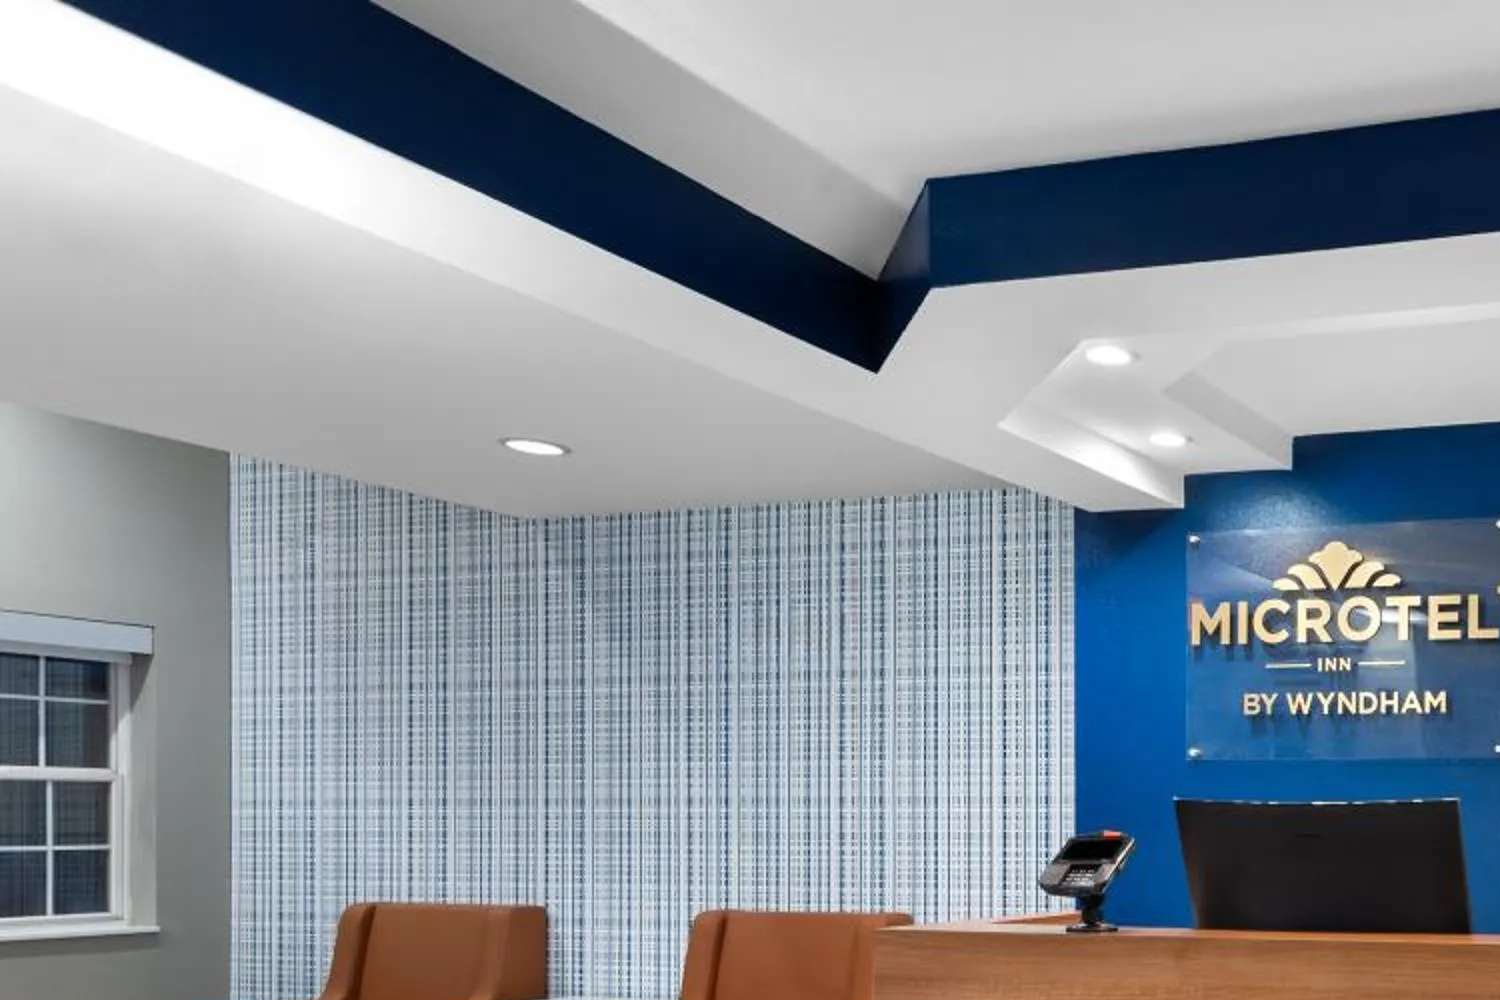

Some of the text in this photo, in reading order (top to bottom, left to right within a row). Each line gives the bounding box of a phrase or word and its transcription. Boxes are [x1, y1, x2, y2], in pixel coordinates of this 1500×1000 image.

[1188, 594, 1500, 645] MICROTEL
[1317, 657, 1351, 672] INN
[1243, 691, 1447, 716] BY WYNDHAM
